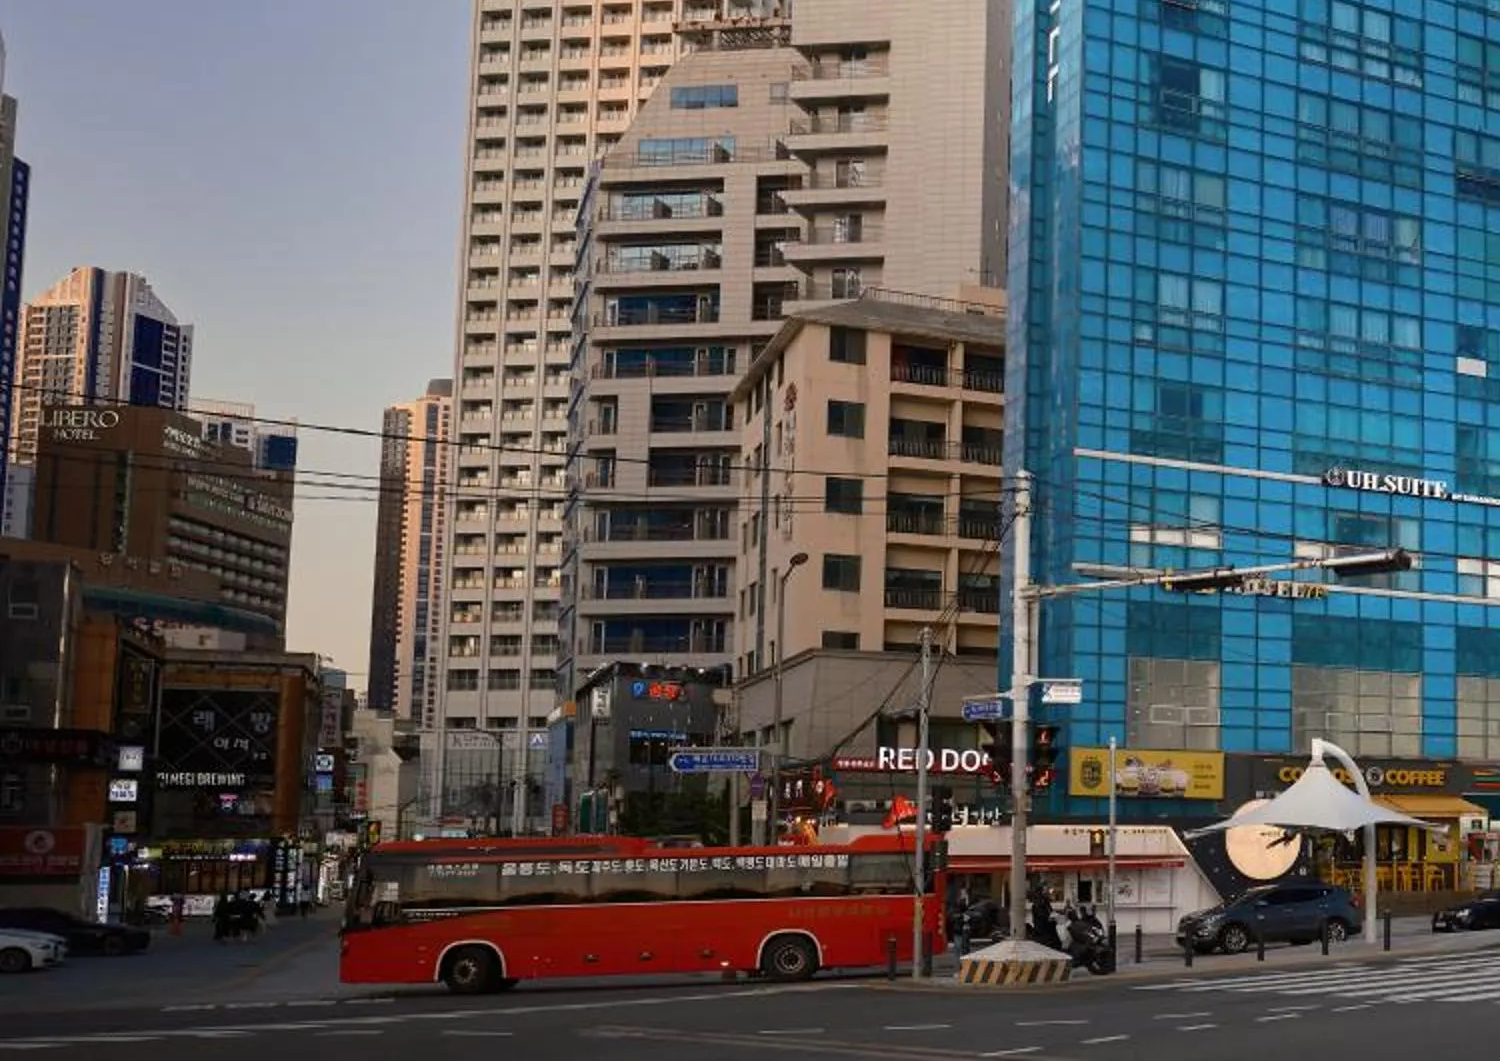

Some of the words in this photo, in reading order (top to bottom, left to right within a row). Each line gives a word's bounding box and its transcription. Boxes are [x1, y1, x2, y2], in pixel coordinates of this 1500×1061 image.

[39, 410, 119, 428] LIBERO
[52, 429, 101, 440] HOTEL
[878, 746, 935, 770] RED
[1385, 769, 1445, 786] COFFEE
